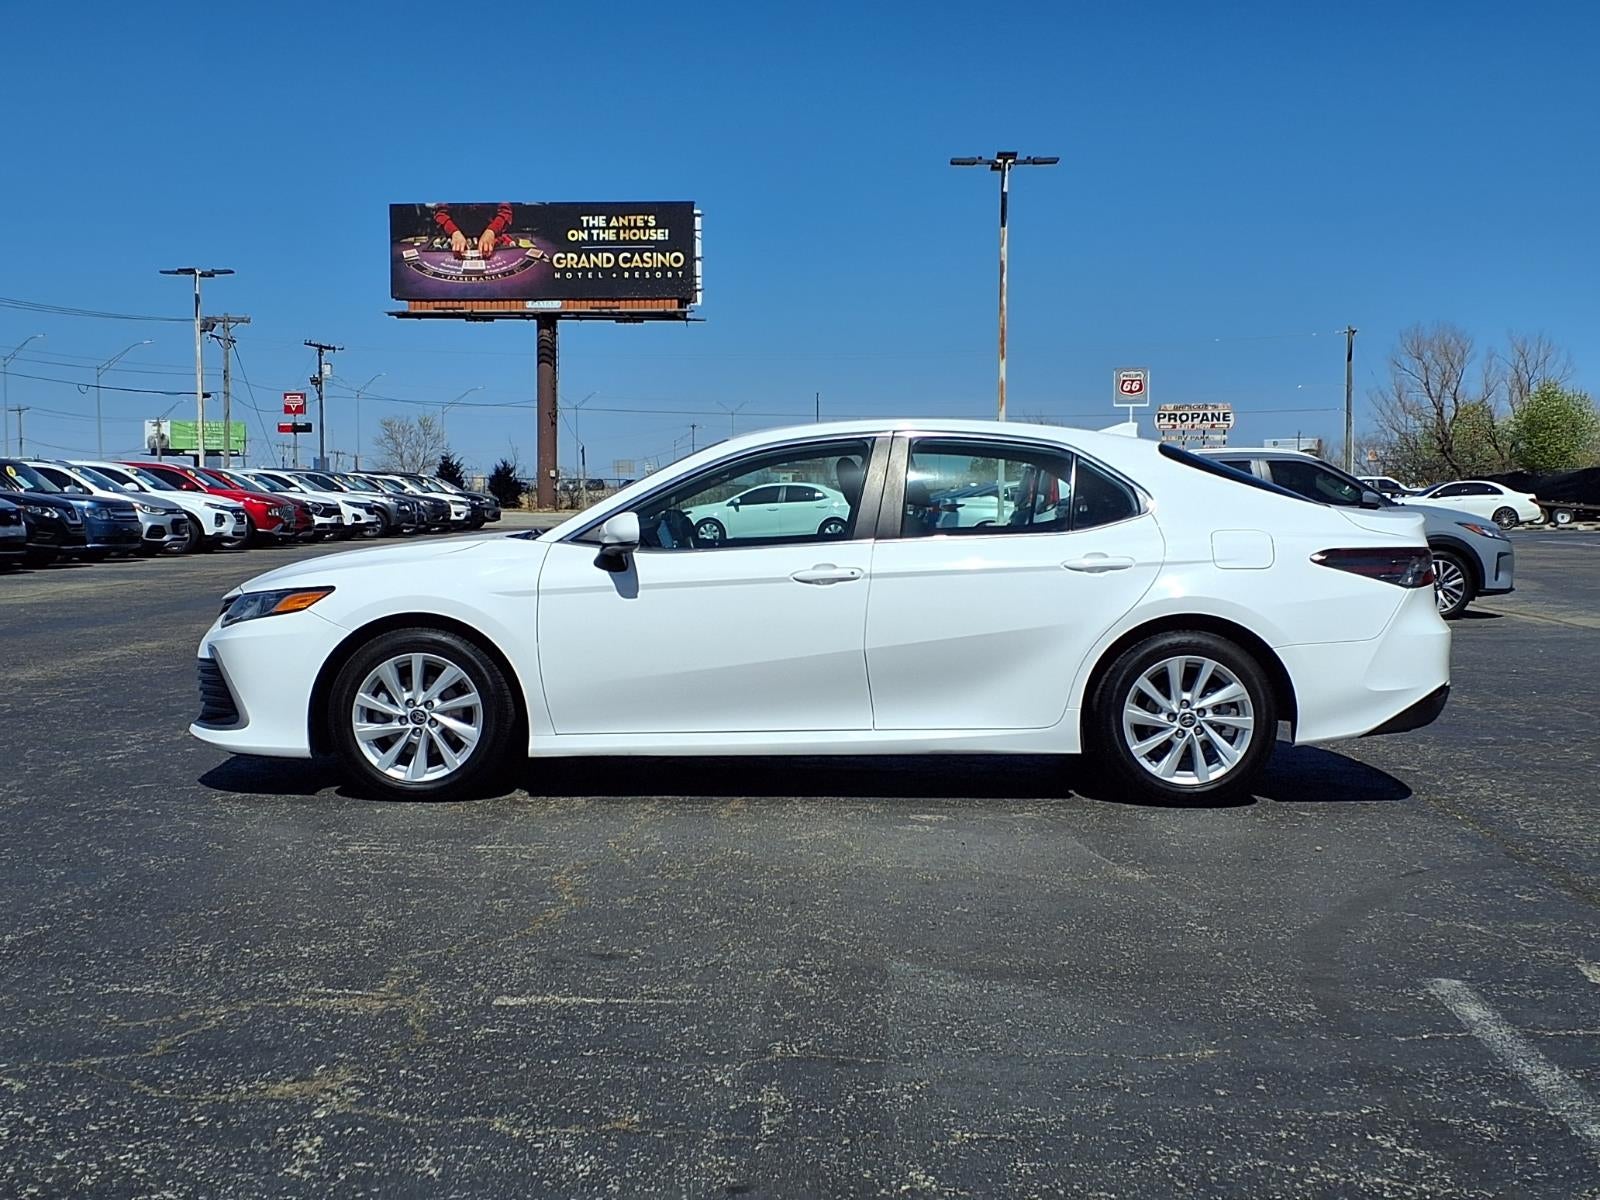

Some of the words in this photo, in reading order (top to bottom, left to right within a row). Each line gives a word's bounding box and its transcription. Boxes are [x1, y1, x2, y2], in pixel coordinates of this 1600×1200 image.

[581, 215, 607, 228] THE
[609, 214, 656, 228] ANTE'S
[567, 229, 588, 241] ON
[591, 229, 617, 241] THE
[619, 228, 669, 241] HOUSE!
[552, 252, 615, 269] GRAND
[618, 251, 685, 268] CASINO
[554, 271, 603, 279] HOTEL
[623, 271, 683, 279] RESORT
[1122, 380, 1140, 391] 66
[1156, 411, 1231, 424] PROPANE
